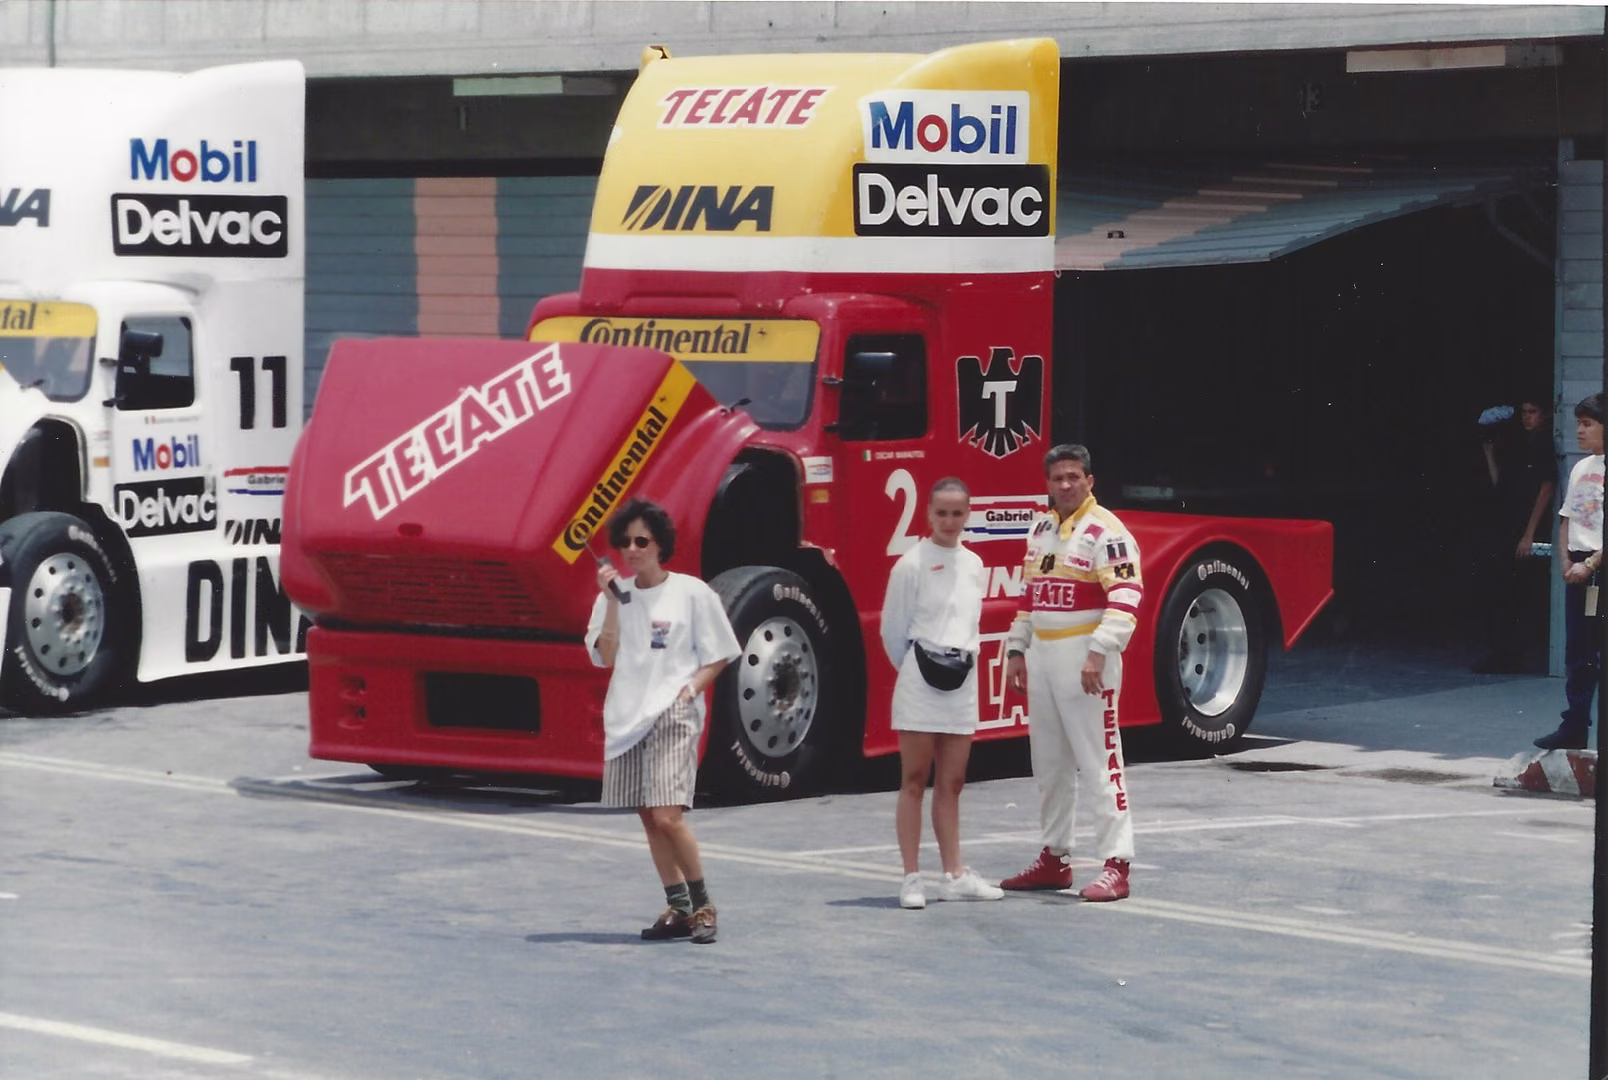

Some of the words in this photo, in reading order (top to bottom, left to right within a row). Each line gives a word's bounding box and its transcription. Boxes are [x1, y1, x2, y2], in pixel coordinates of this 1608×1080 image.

[660, 86, 831, 126] TECATE
[869, 101, 1017, 155] Mobil
[129, 138, 257, 182] Mobil
[117, 199, 282, 245] Delvac
[621, 184, 775, 231] DINA
[858, 172, 1043, 227] Delvac
[580, 318, 752, 354] Continental
[230, 356, 287, 430] 11
[982, 380, 1018, 428] T
[132, 435, 200, 471] Mobil
[344, 342, 572, 521] TECATE
[247, 475, 285, 485] Gabrie
[564, 405, 668, 551] Continental
[118, 487, 217, 530] Delvac
[224, 518, 281, 545] DIN
[884, 468, 920, 557] 2
[985, 510, 1034, 522] Gabriel
[1101, 689, 1128, 811] TECATE
